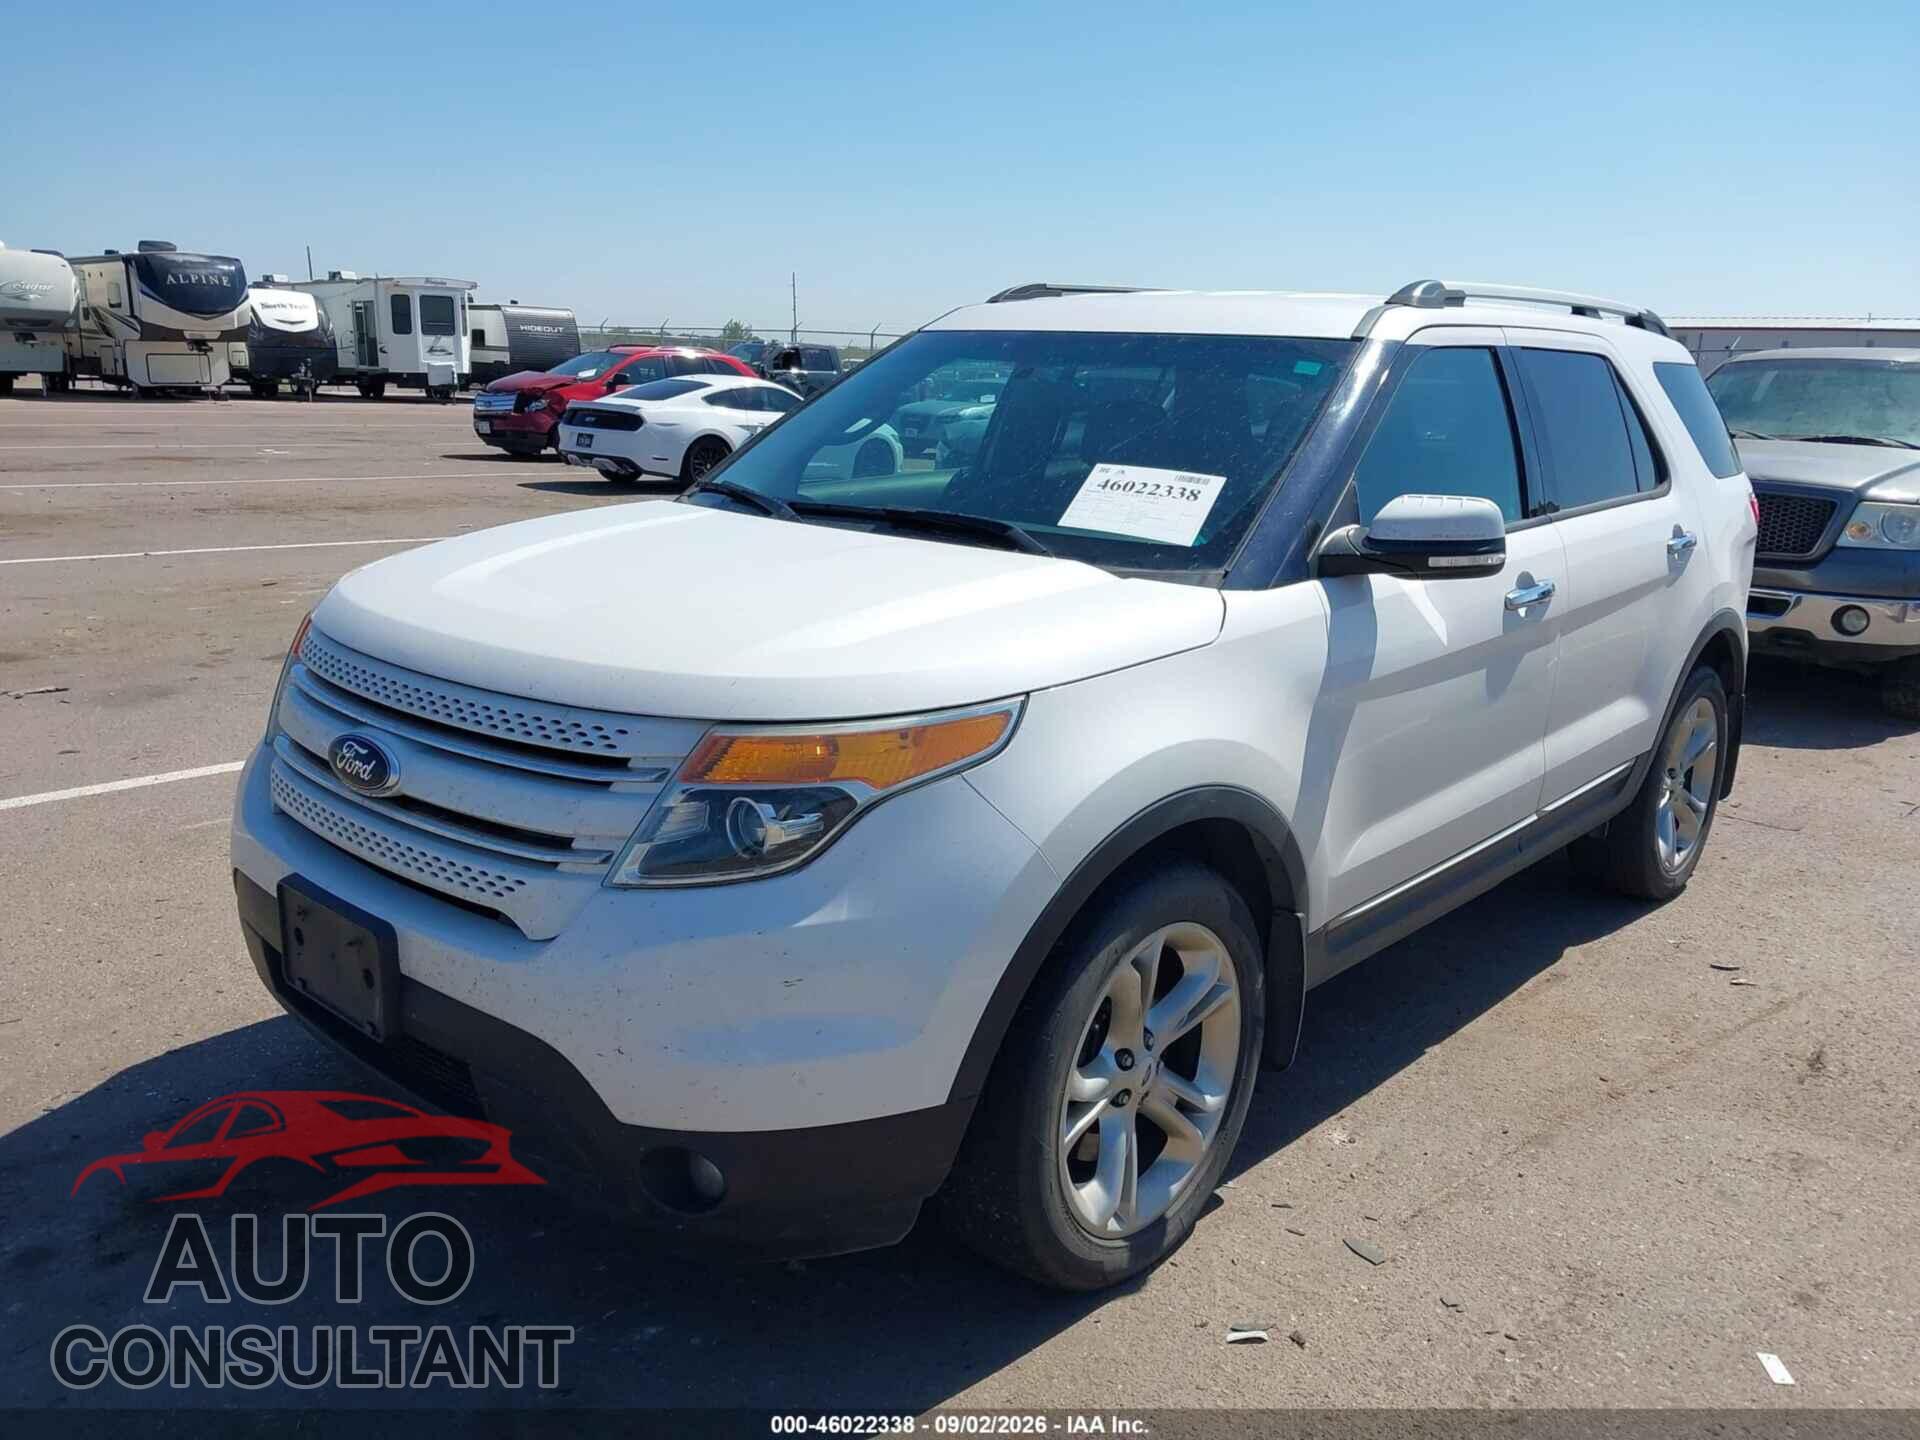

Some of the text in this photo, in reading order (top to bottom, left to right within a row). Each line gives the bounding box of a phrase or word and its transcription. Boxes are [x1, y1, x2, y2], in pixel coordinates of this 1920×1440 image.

[166, 273, 231, 287] ALPINE
[520, 324, 563, 333] HIDEOUT
[1097, 478, 1202, 502] 46022338
[336, 741, 376, 781] Ford
